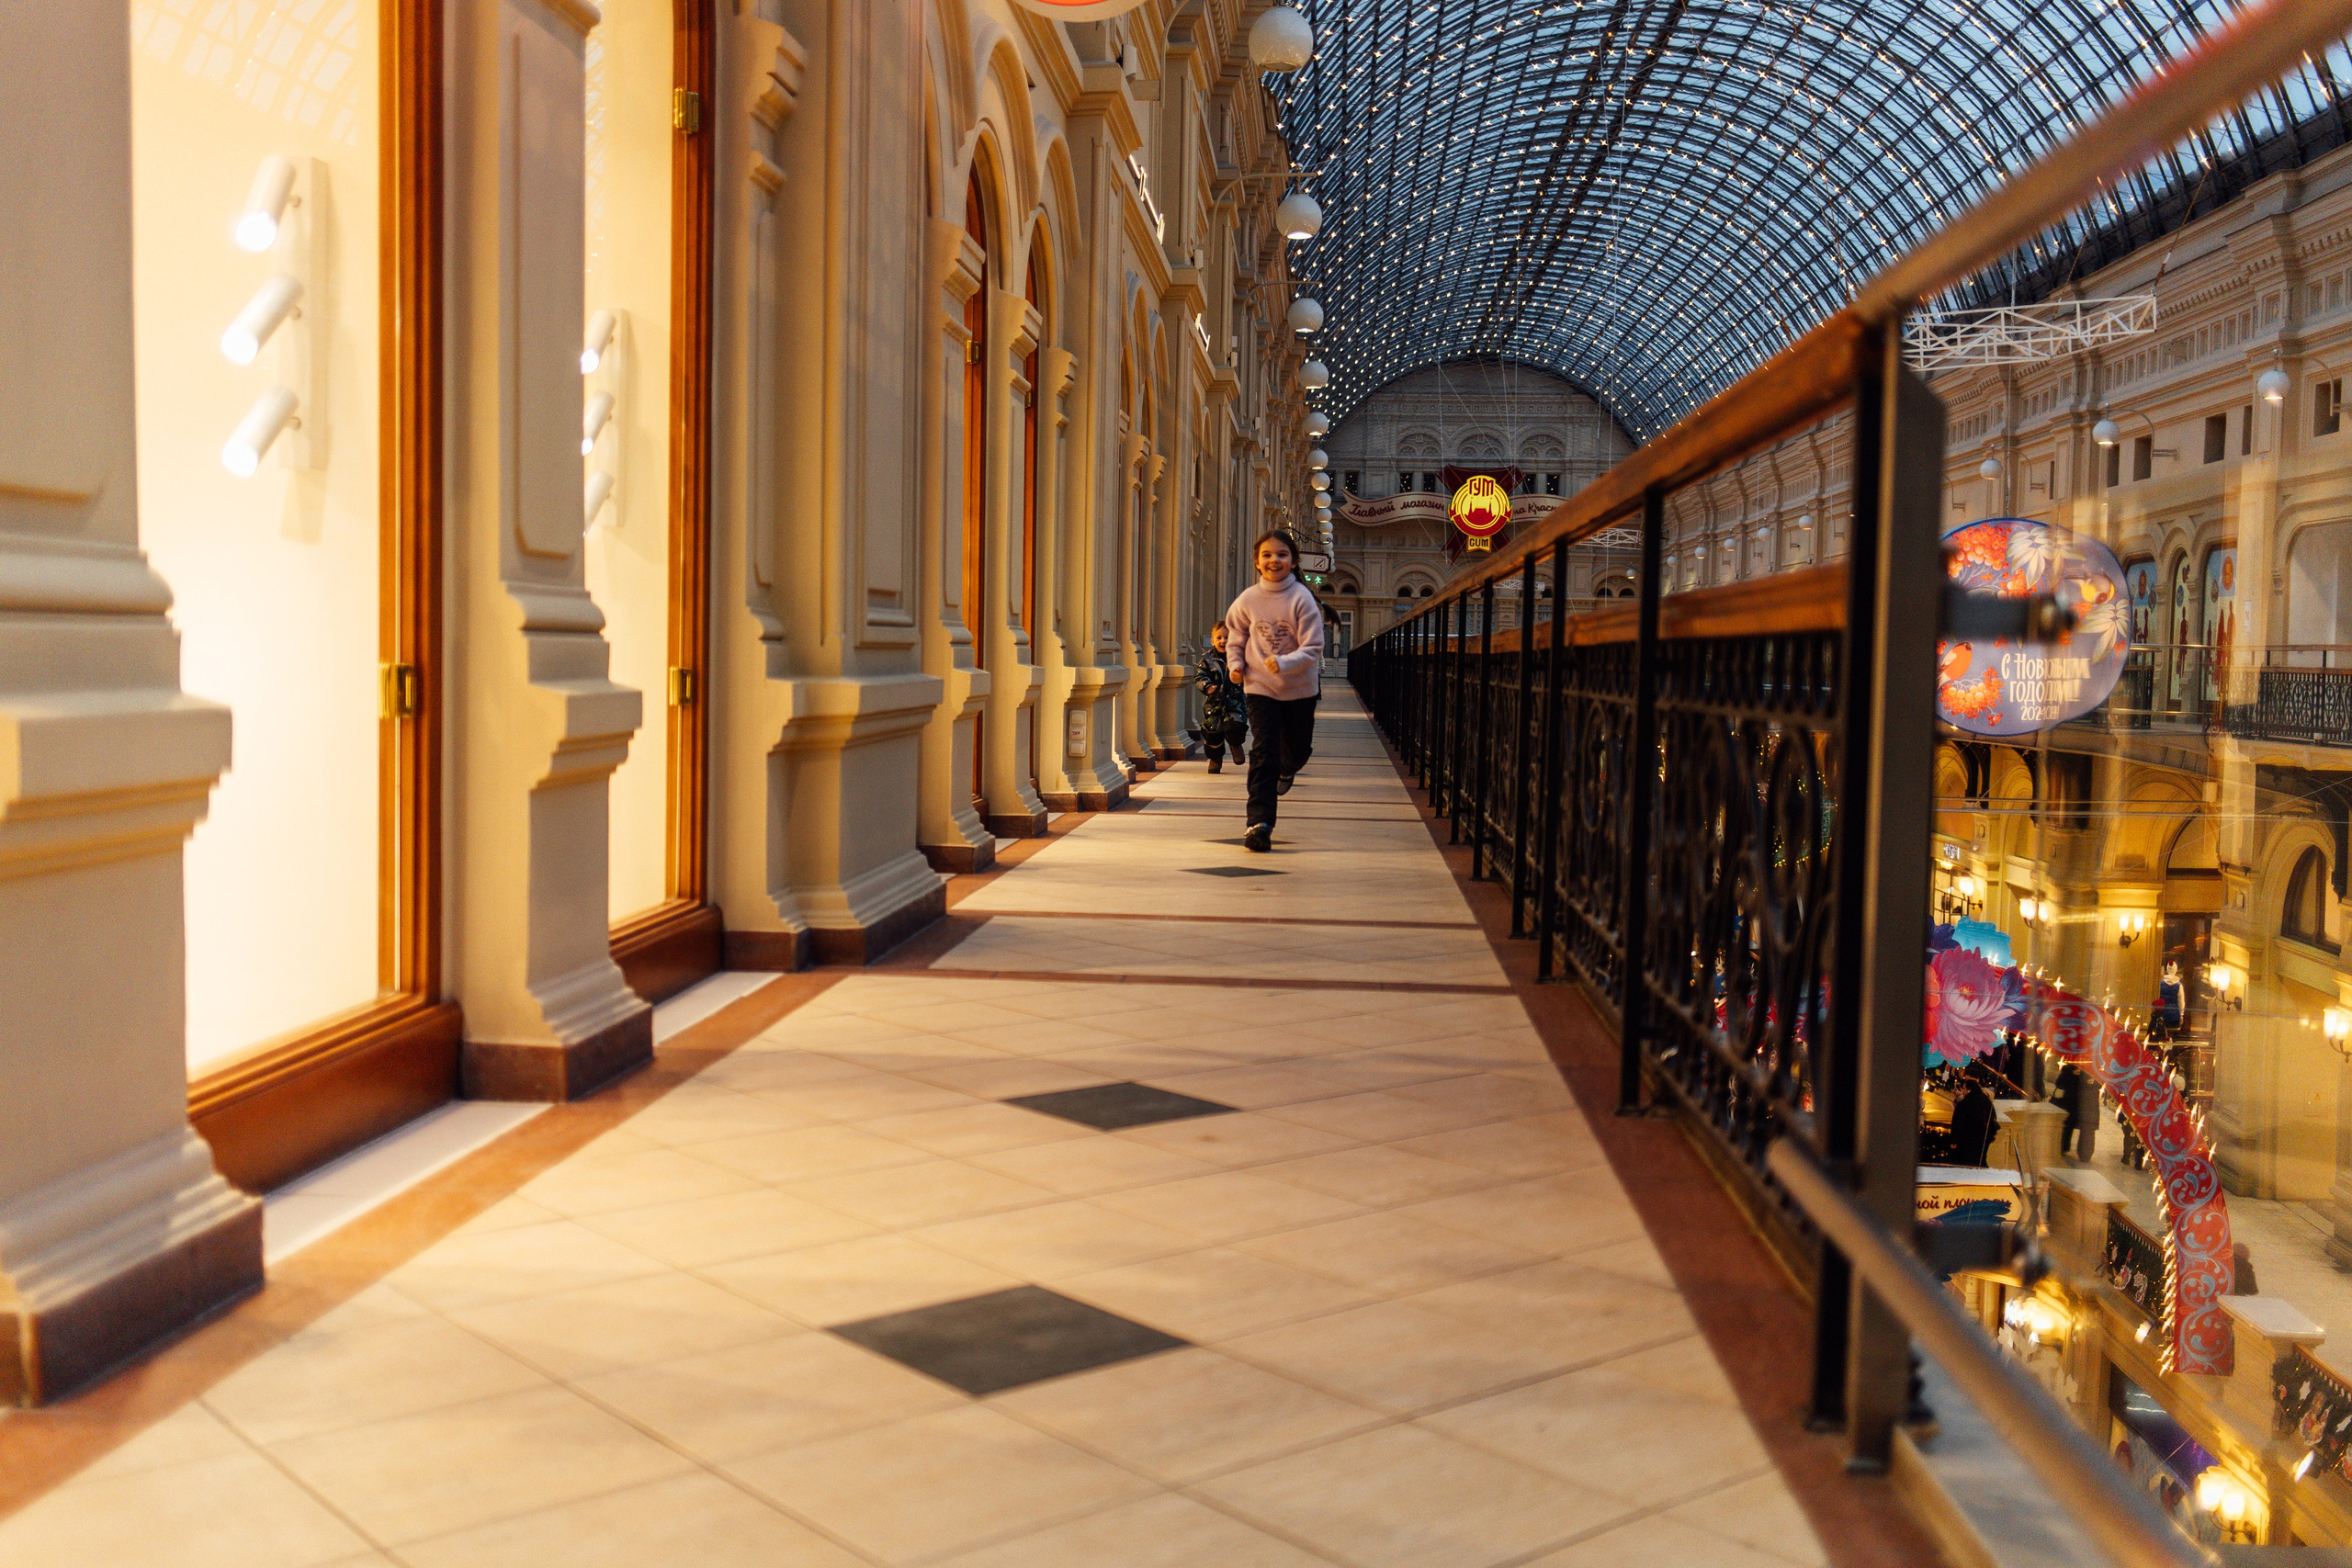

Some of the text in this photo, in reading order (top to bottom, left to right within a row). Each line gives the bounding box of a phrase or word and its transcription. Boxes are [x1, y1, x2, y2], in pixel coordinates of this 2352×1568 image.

[1469, 478, 1494, 497] ГУМ
[1348, 502, 1396, 517] Главный
[1400, 500, 1445, 512] магазин
[1469, 538, 1488, 547] GUM
[2001, 653, 2010, 680] С
